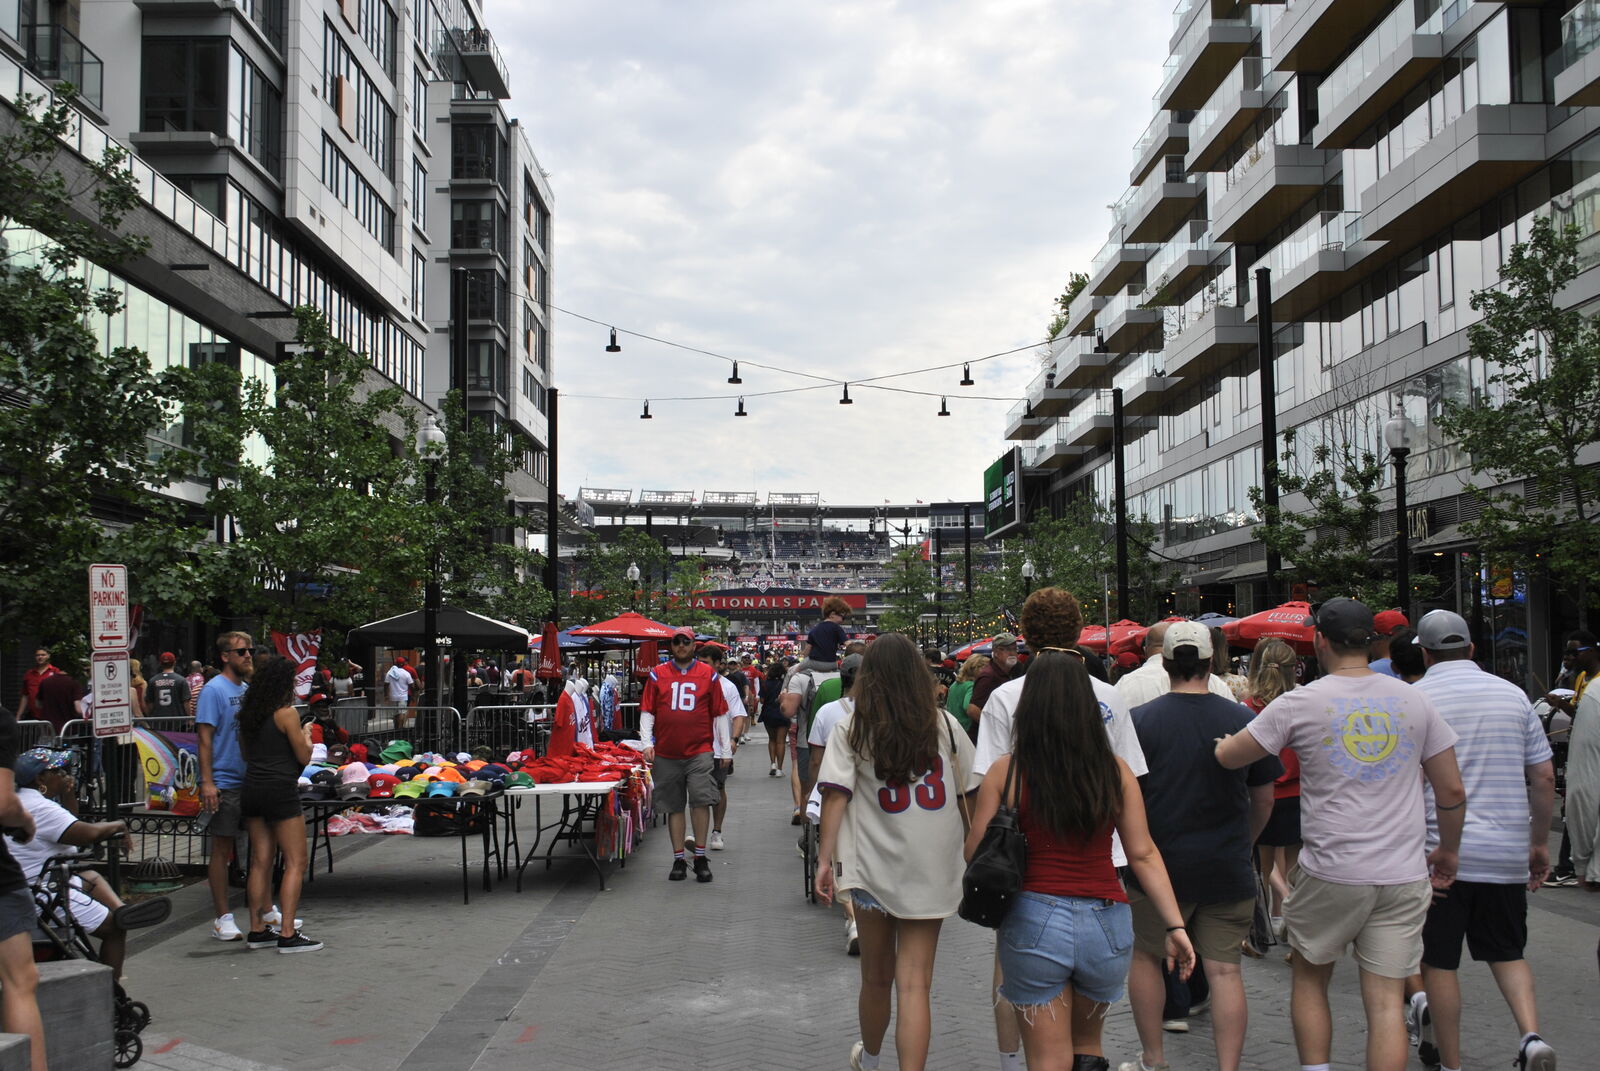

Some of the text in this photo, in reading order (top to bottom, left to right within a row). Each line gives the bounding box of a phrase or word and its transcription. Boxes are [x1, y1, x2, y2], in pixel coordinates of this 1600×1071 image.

[1407, 508, 1428, 540] TLAS
[101, 572, 115, 588] NO
[93, 591, 125, 607] PARKING
[686, 597, 820, 608] NATIONALS PA
[102, 620, 118, 632] TIME
[159, 688, 172, 706] 5
[671, 681, 697, 712] 16
[1330, 696, 1403, 714] TAKE
[1330, 716, 1401, 736] CARE
[1356, 741, 1386, 758] OF
